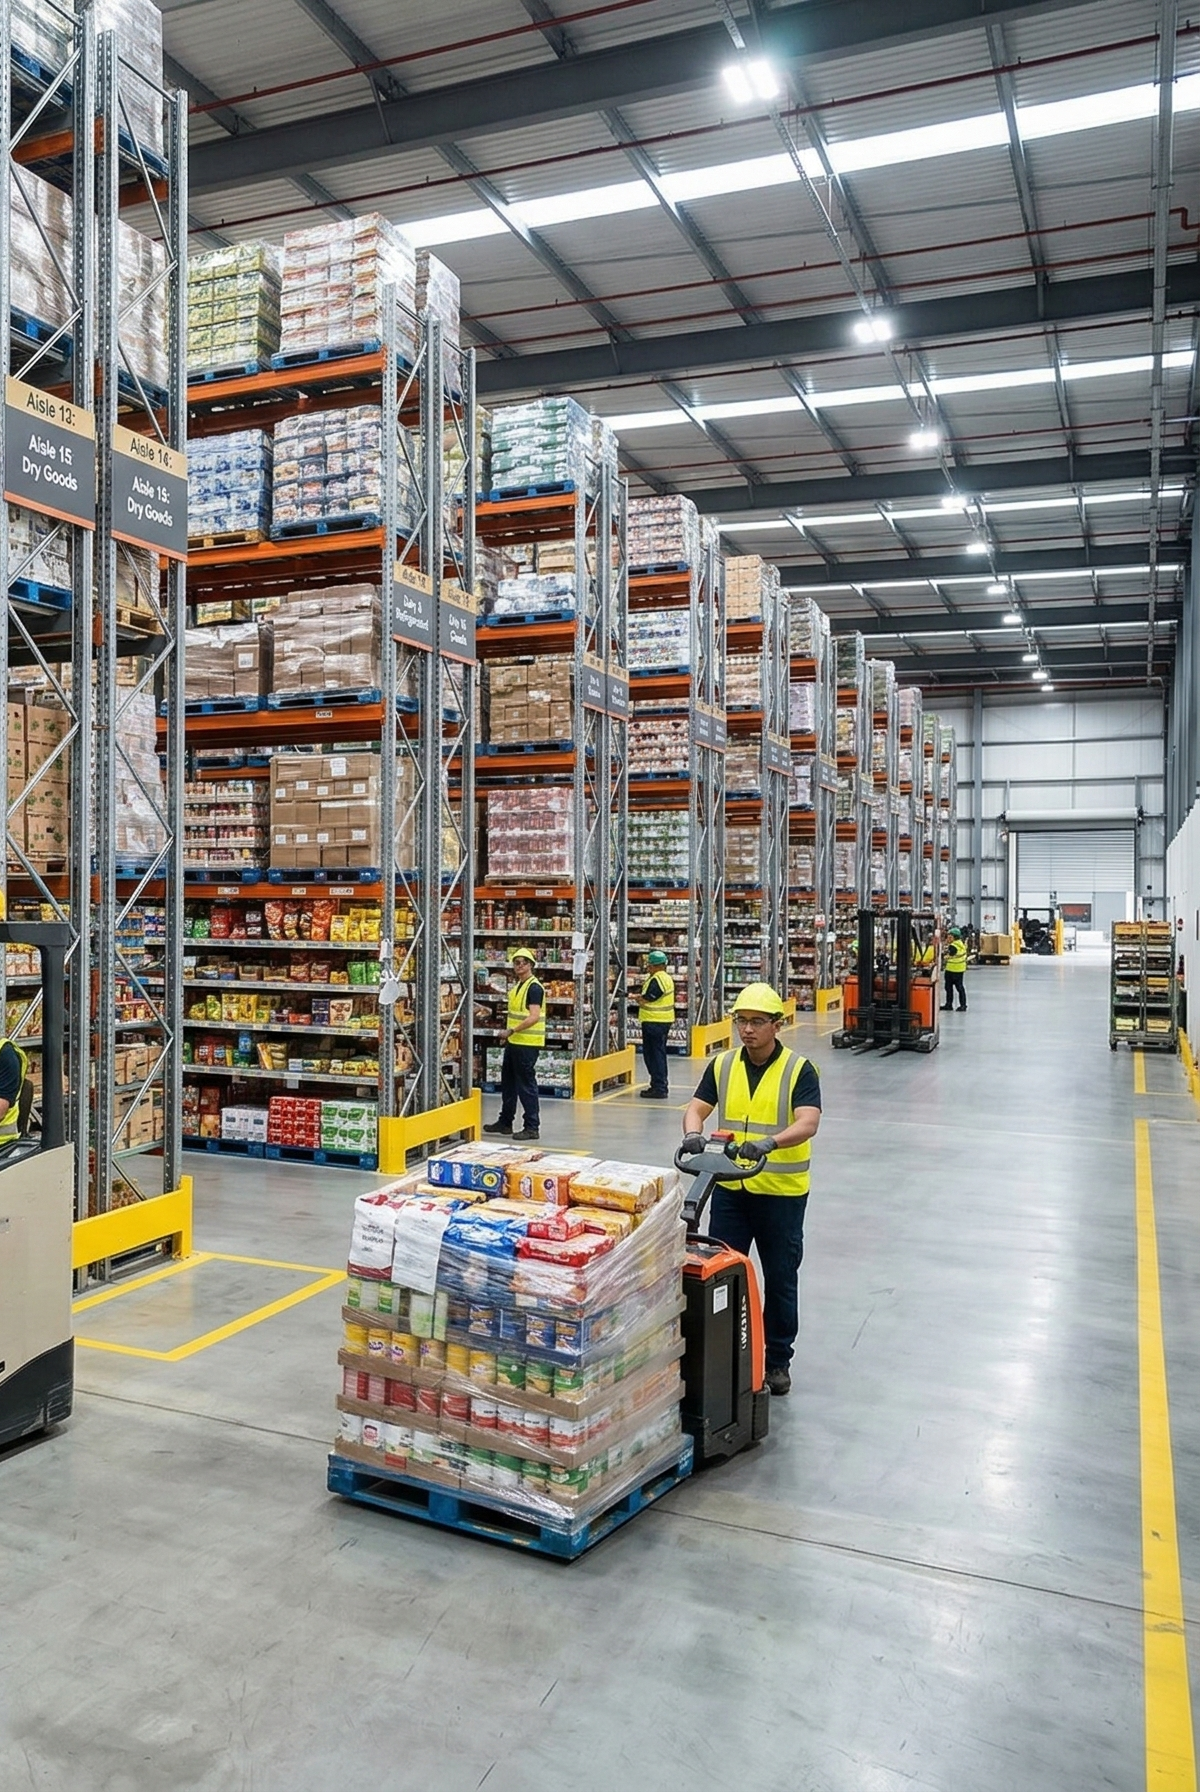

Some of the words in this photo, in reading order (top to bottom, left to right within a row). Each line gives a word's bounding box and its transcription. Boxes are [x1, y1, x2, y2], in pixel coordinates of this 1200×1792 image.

[26, 391, 56, 418] Aisle
[28, 434, 56, 460] Aisle
[130, 437, 155, 461] Aisle
[22, 455, 42, 482] Dry
[43, 464, 78, 492] Goods
[132, 476, 154, 500] Aisle
[127, 496, 144, 520] Dry
[145, 504, 173, 527] Goods
